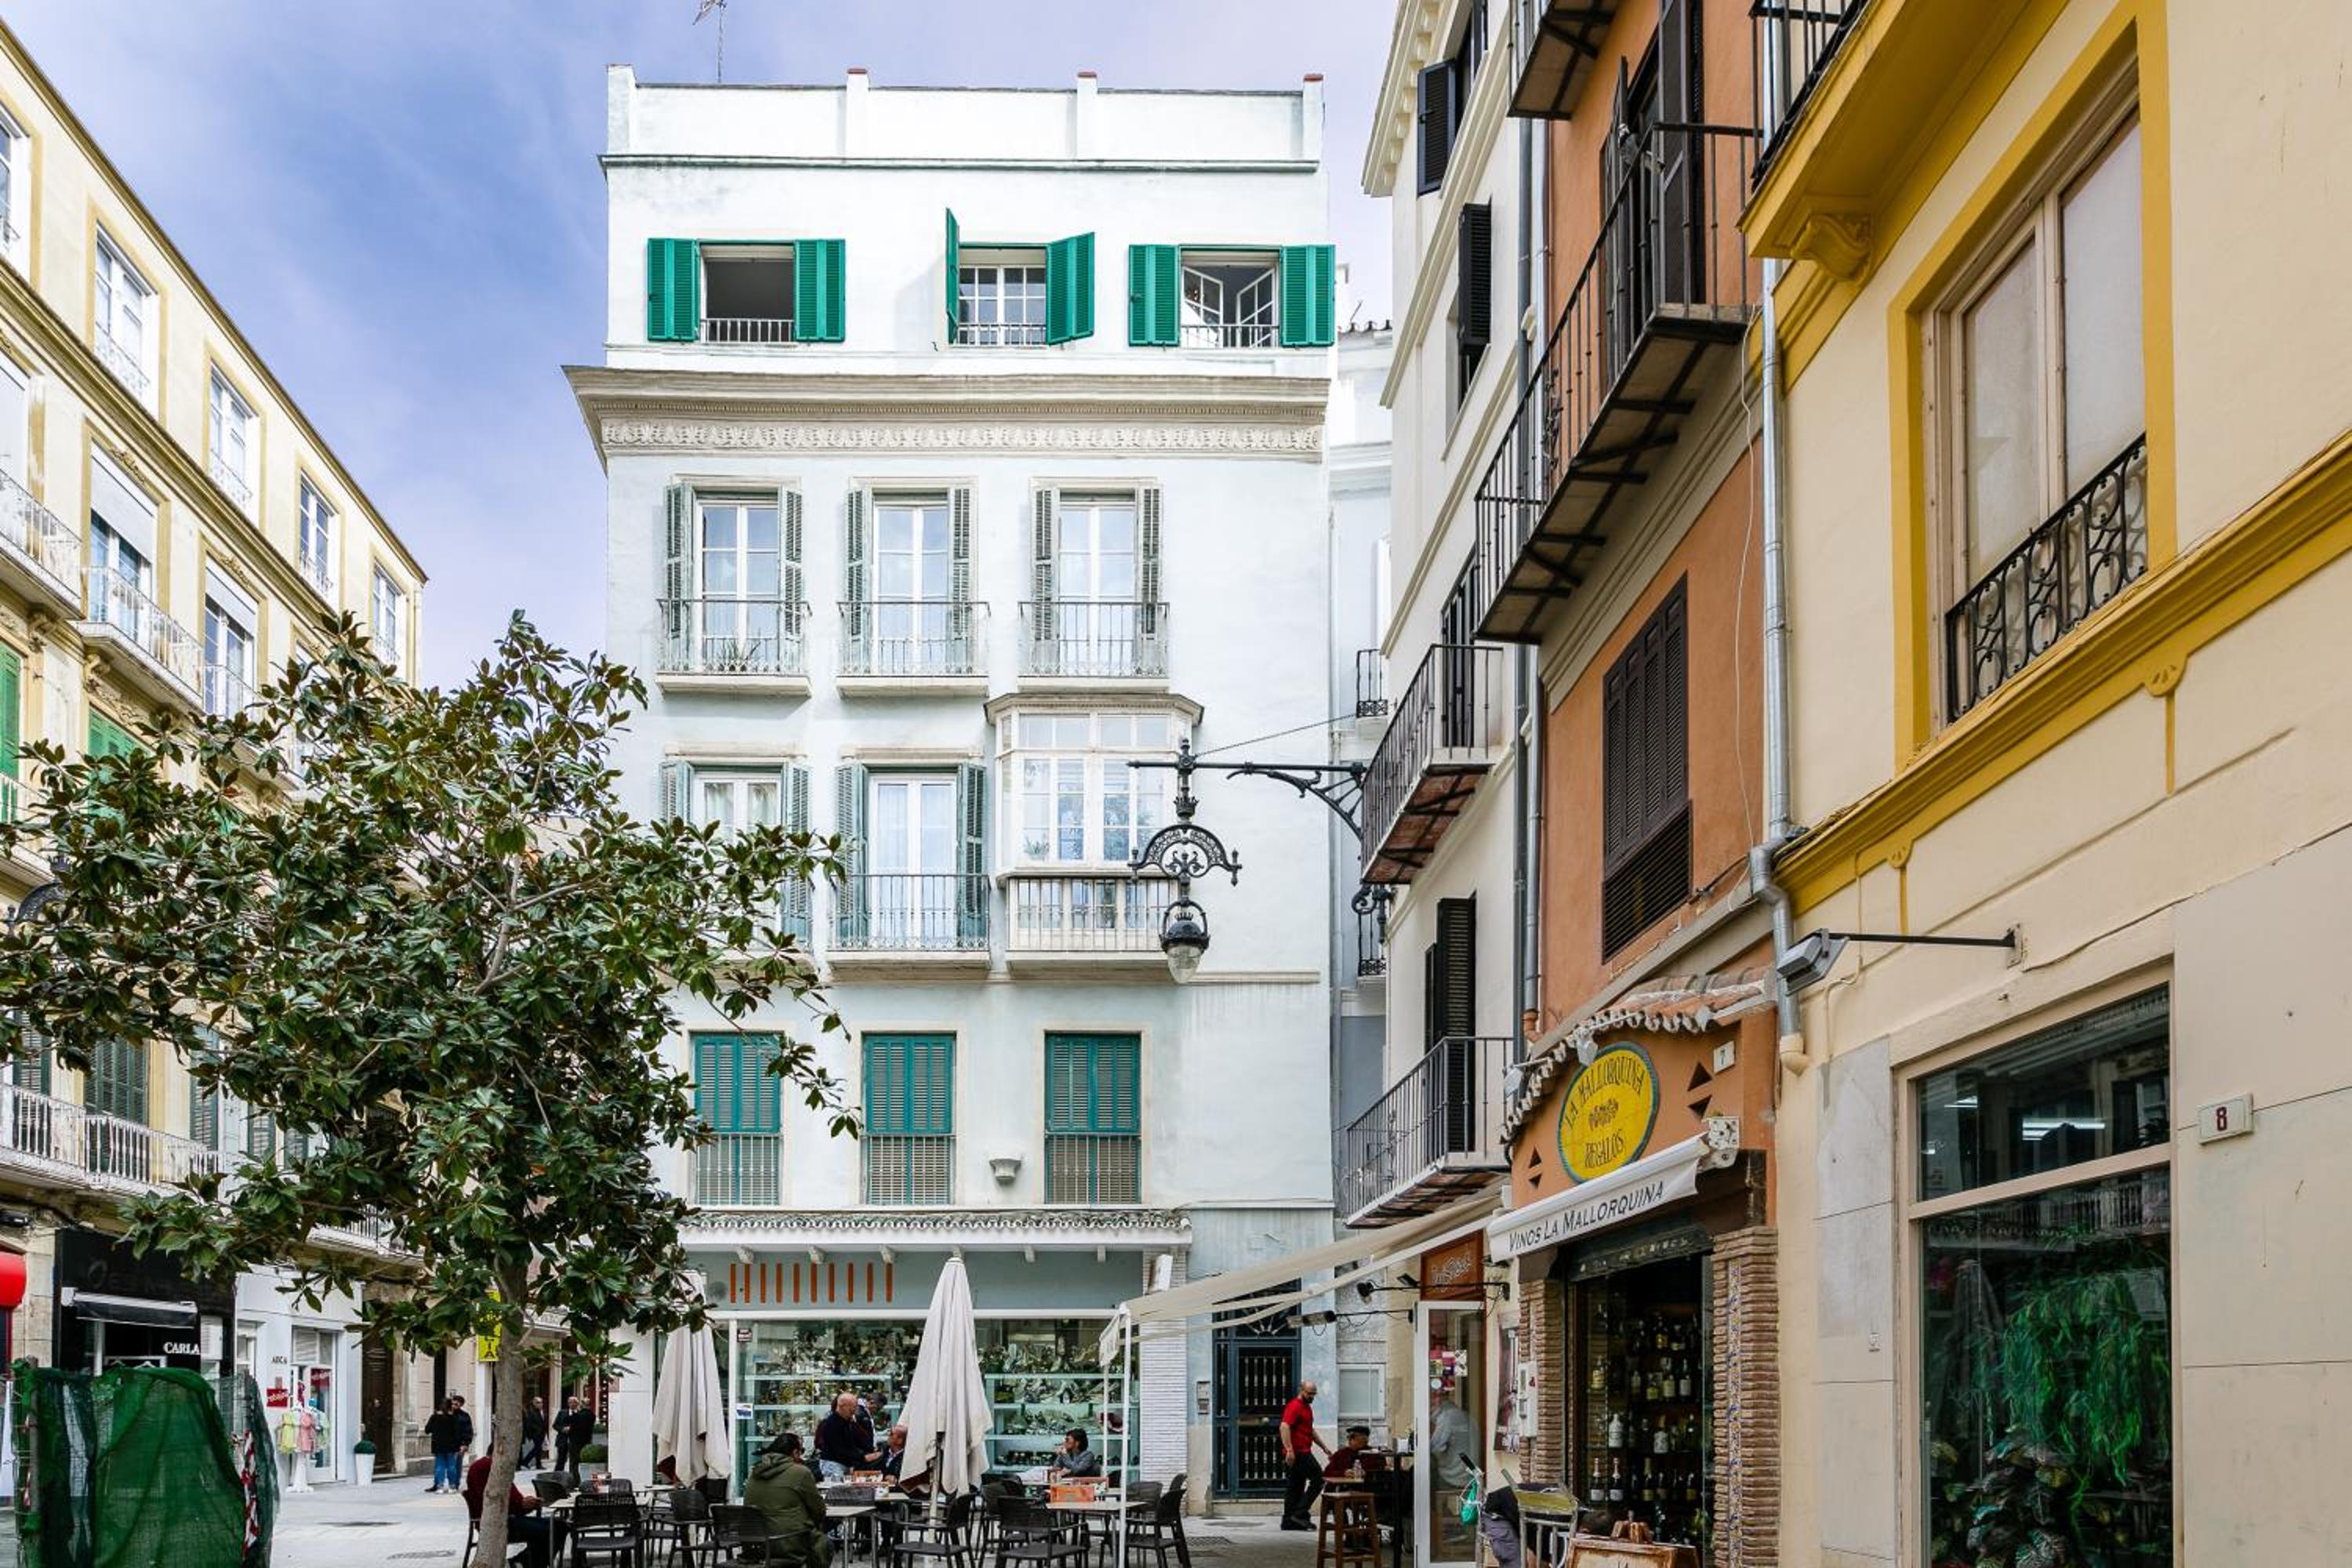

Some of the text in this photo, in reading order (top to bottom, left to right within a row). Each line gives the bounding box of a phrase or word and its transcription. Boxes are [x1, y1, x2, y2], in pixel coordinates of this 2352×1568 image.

[1719, 1048, 1726, 1065] 7
[1564, 1055, 1646, 1131] LA MALLORQUINA
[2216, 1106, 2227, 1131] 8
[1584, 1128, 1624, 1169] REGALOS
[1508, 1181, 1664, 1252] VINOS LA MALLORQUINA
[163, 1341, 201, 1356] CARLA
